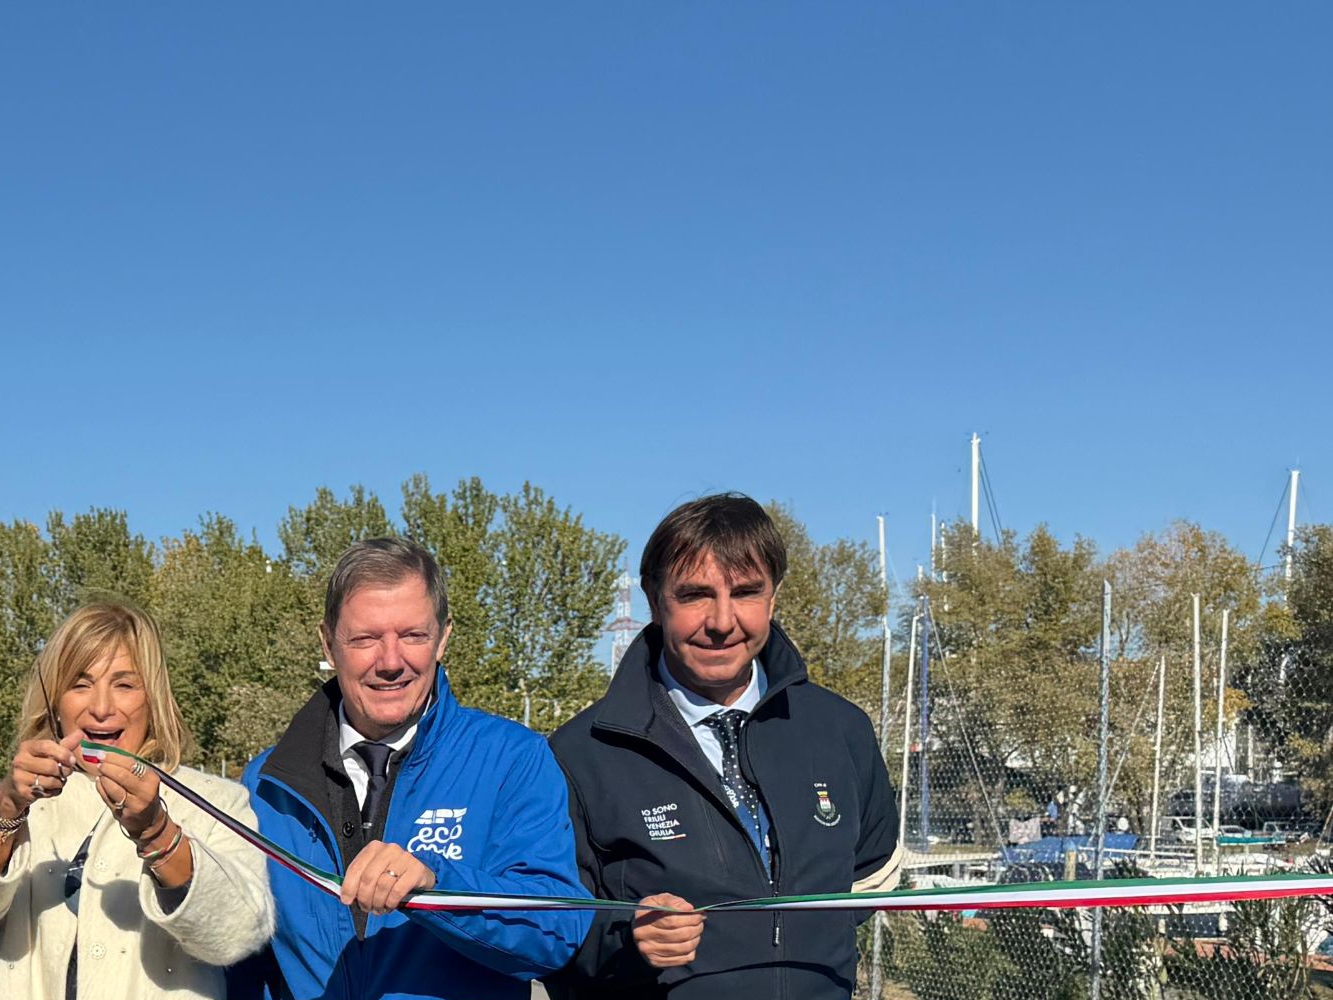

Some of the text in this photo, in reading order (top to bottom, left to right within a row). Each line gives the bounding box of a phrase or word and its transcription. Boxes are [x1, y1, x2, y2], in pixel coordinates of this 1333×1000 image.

[652, 803, 677, 815] SONO
[644, 814, 666, 822] FRIULI
[646, 819, 680, 829] VENEZIA
[418, 824, 463, 844] eco
